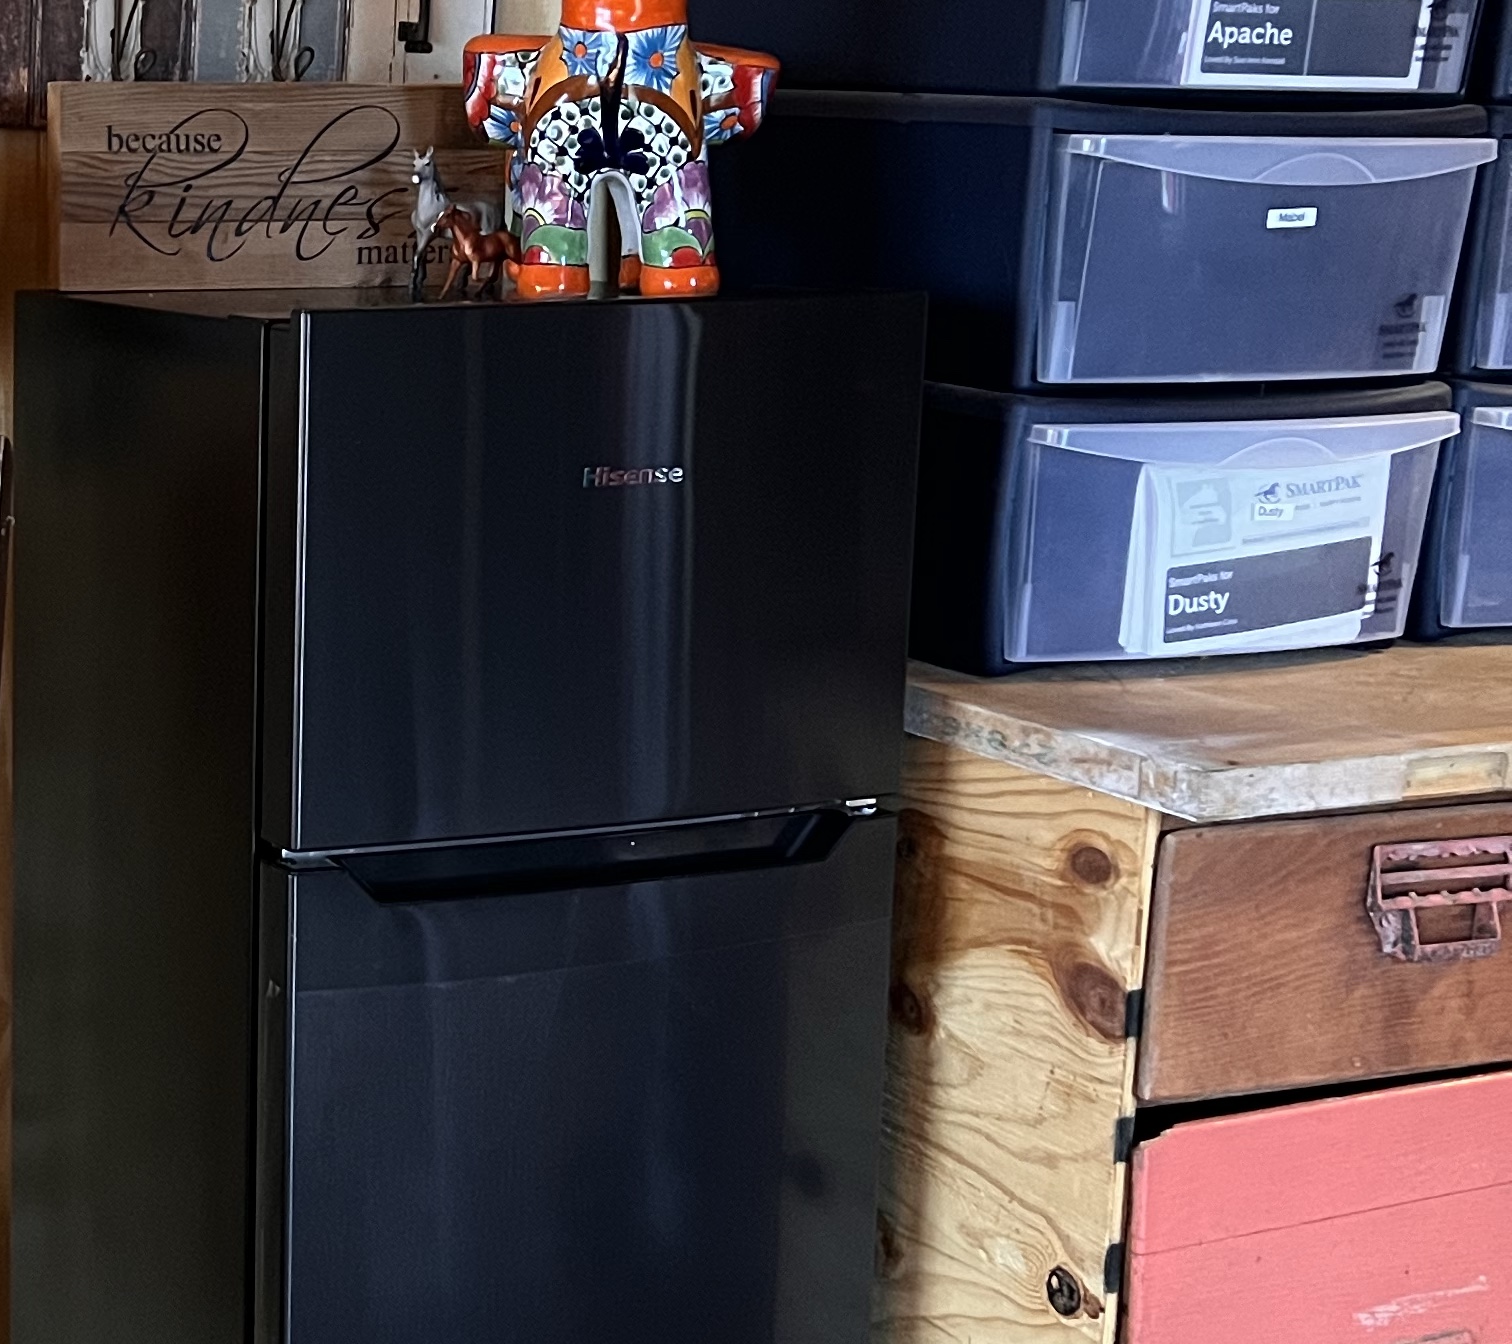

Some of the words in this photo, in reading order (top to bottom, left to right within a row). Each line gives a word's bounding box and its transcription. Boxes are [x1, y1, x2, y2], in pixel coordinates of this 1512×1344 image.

[1207, 20, 1293, 49] Apache
[107, 126, 222, 154] because
[356, 242, 452, 265] mater
[583, 466, 684, 488] Hisense
[1258, 506, 1284, 518] Dusty
[1168, 590, 1230, 616] Dusty
